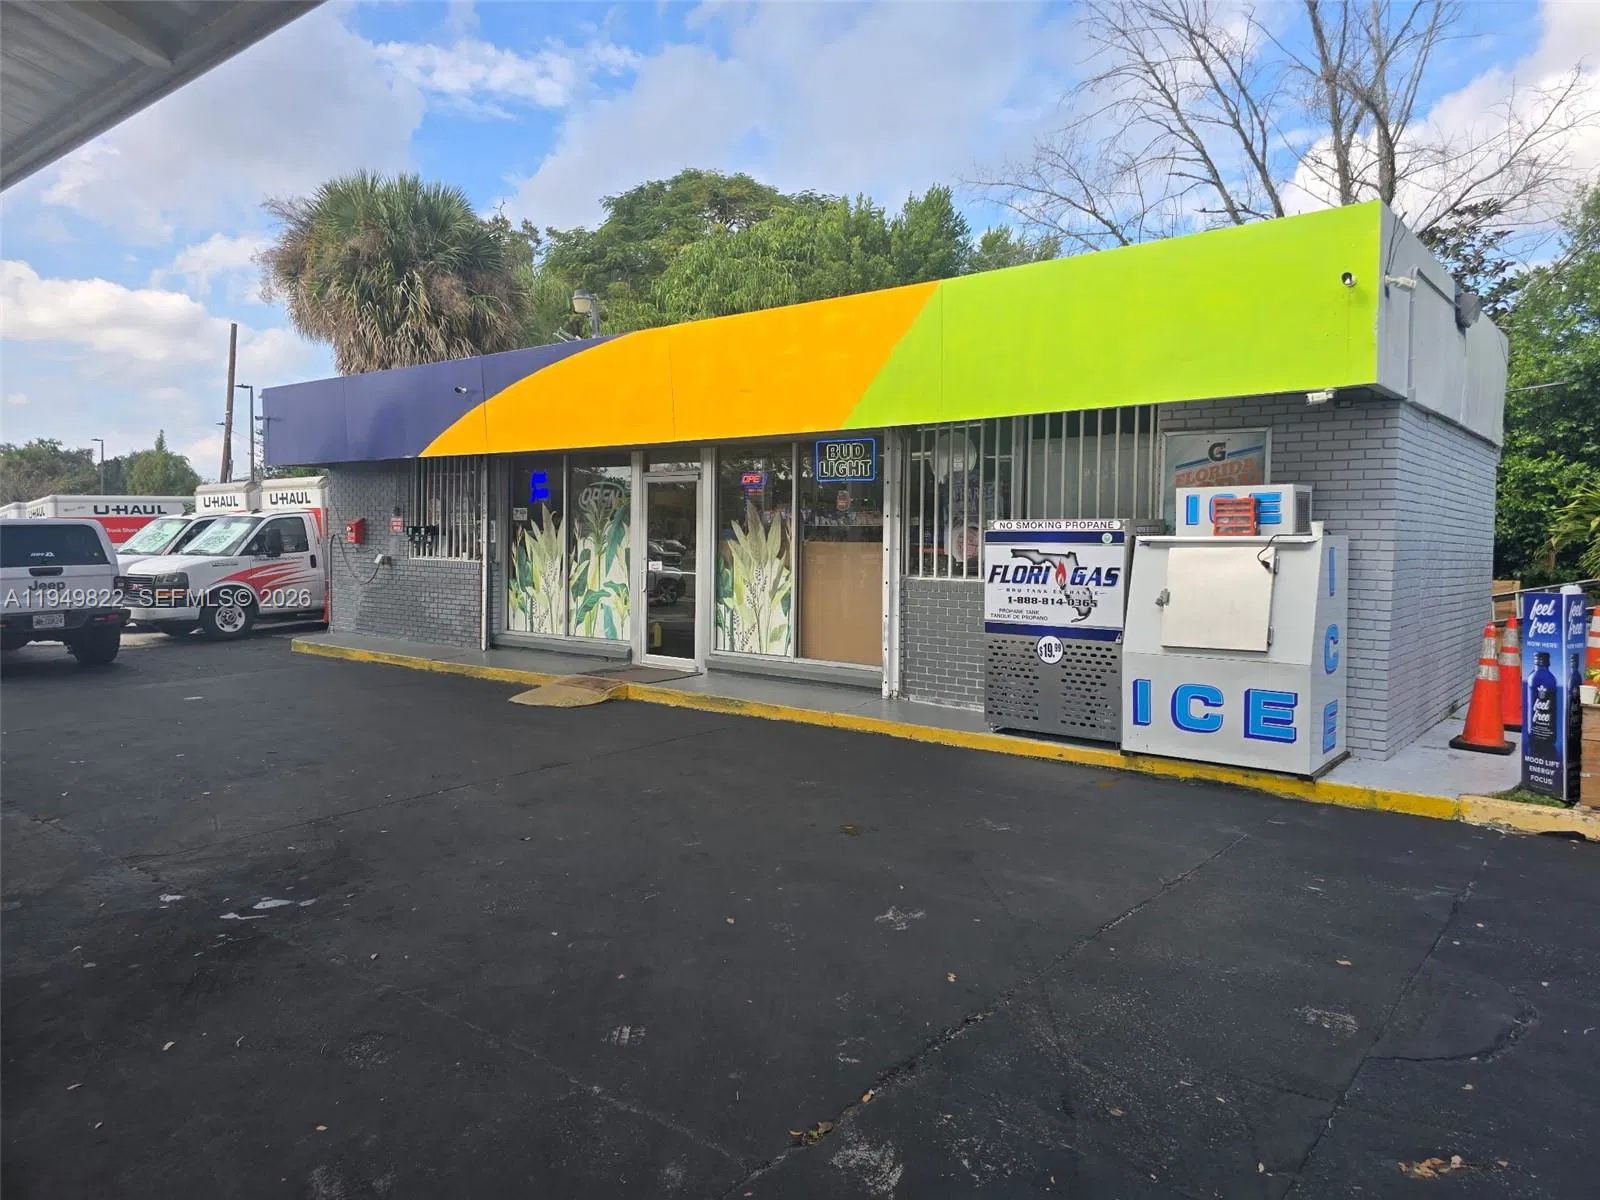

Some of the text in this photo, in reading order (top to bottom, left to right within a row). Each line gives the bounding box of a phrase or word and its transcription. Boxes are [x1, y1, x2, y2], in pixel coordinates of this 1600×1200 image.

[826, 443, 865, 460] BUD
[1208, 442, 1226, 461] G
[819, 460, 872, 477] LIGHT
[1175, 457, 1256, 485] FLORIDA
[742, 475, 764, 484] OPE
[203, 495, 239, 508] U-HAUL
[270, 491, 311, 505] U-HAUL
[93, 504, 167, 515] U-HAUL
[1016, 521, 1062, 529] SMOKING
[1065, 521, 1114, 529] PROPANE
[988, 564, 1121, 587] FLORI GAS
[28, 580, 66, 592] Jeep
[1007, 596, 1098, 607] 1-888-814-0365
[1529, 599, 1556, 620] feel
[1568, 600, 1584, 622] feel
[1528, 617, 1556, 638] free
[1039, 642, 1062, 658] $19.99
[1132, 678, 1298, 744] ICE
[1533, 698, 1551, 711] feel
[1532, 711, 1551, 723] free
[1524, 755, 1560, 769] MOOD LIFT
[1529, 765, 1555, 776] ENERGY
[1530, 774, 1553, 785] FOCUS
